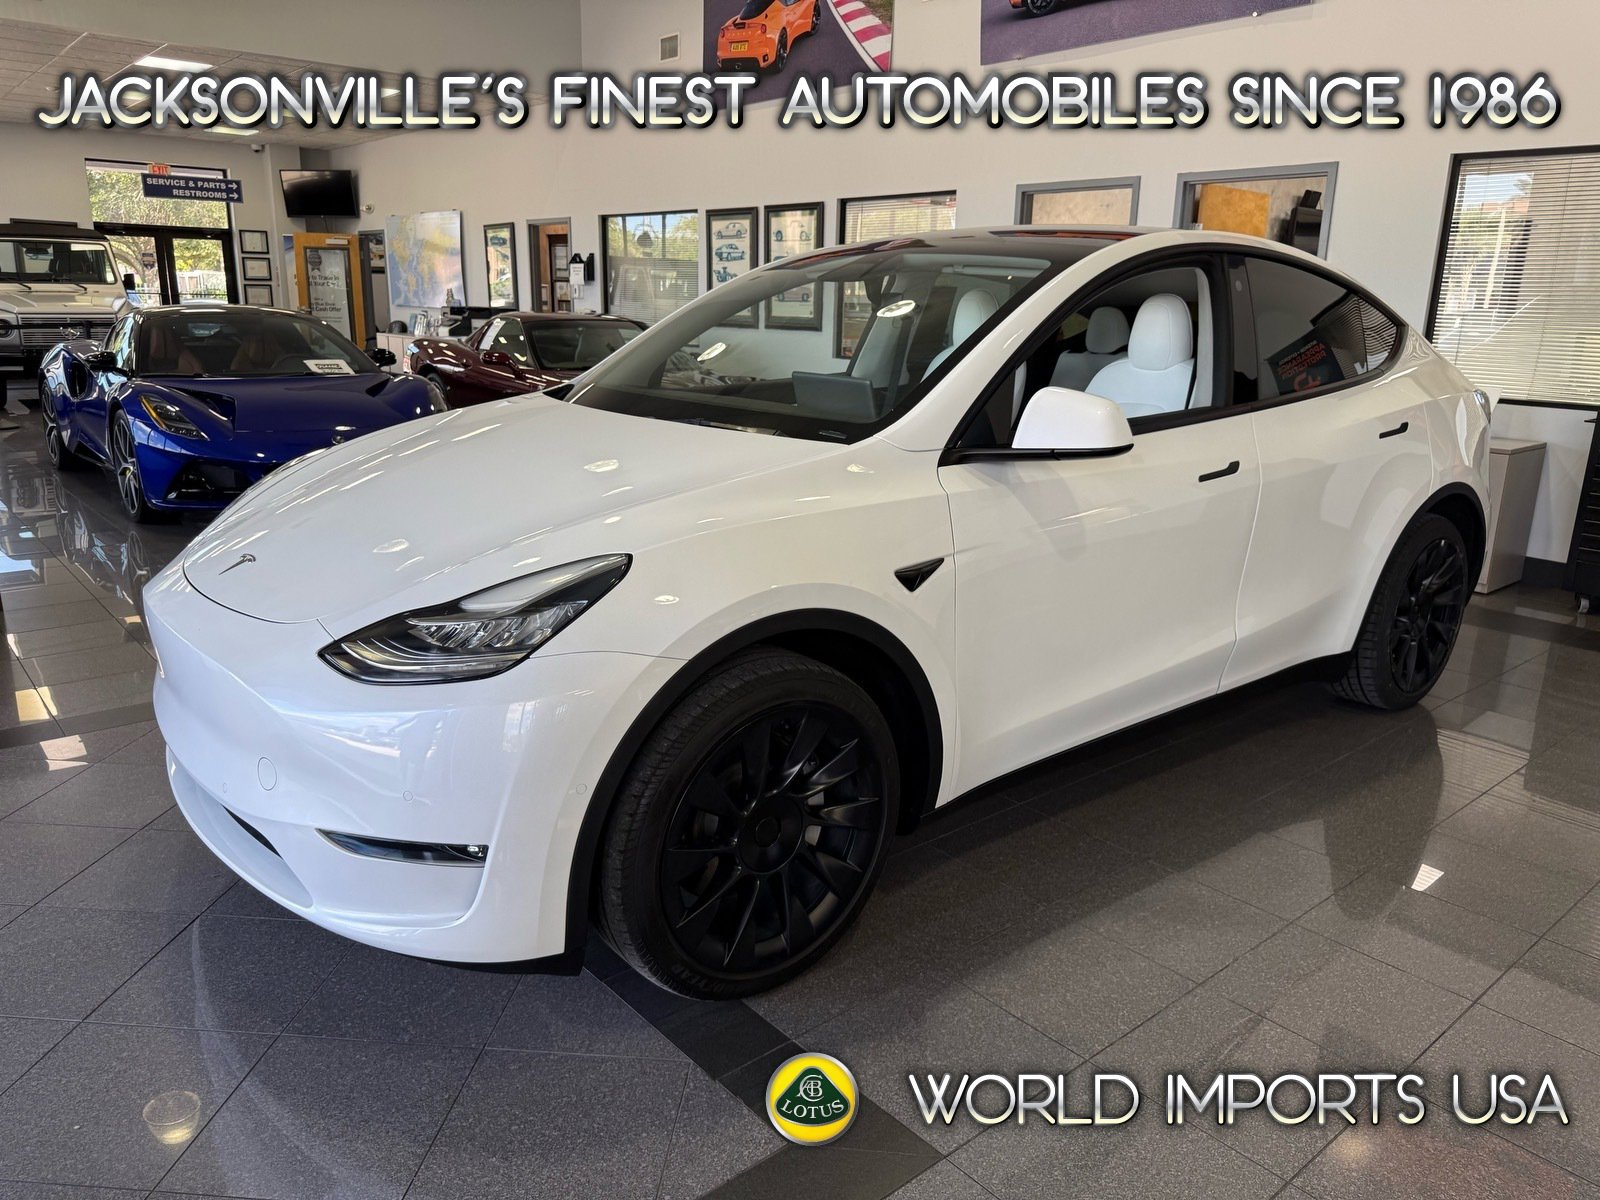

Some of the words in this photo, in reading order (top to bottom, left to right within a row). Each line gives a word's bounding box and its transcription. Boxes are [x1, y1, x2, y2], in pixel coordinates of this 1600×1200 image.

[146, 178, 186, 186] SERVICE
[197, 181, 226, 189] PARTS
[172, 189, 227, 199] RESTROOMS
